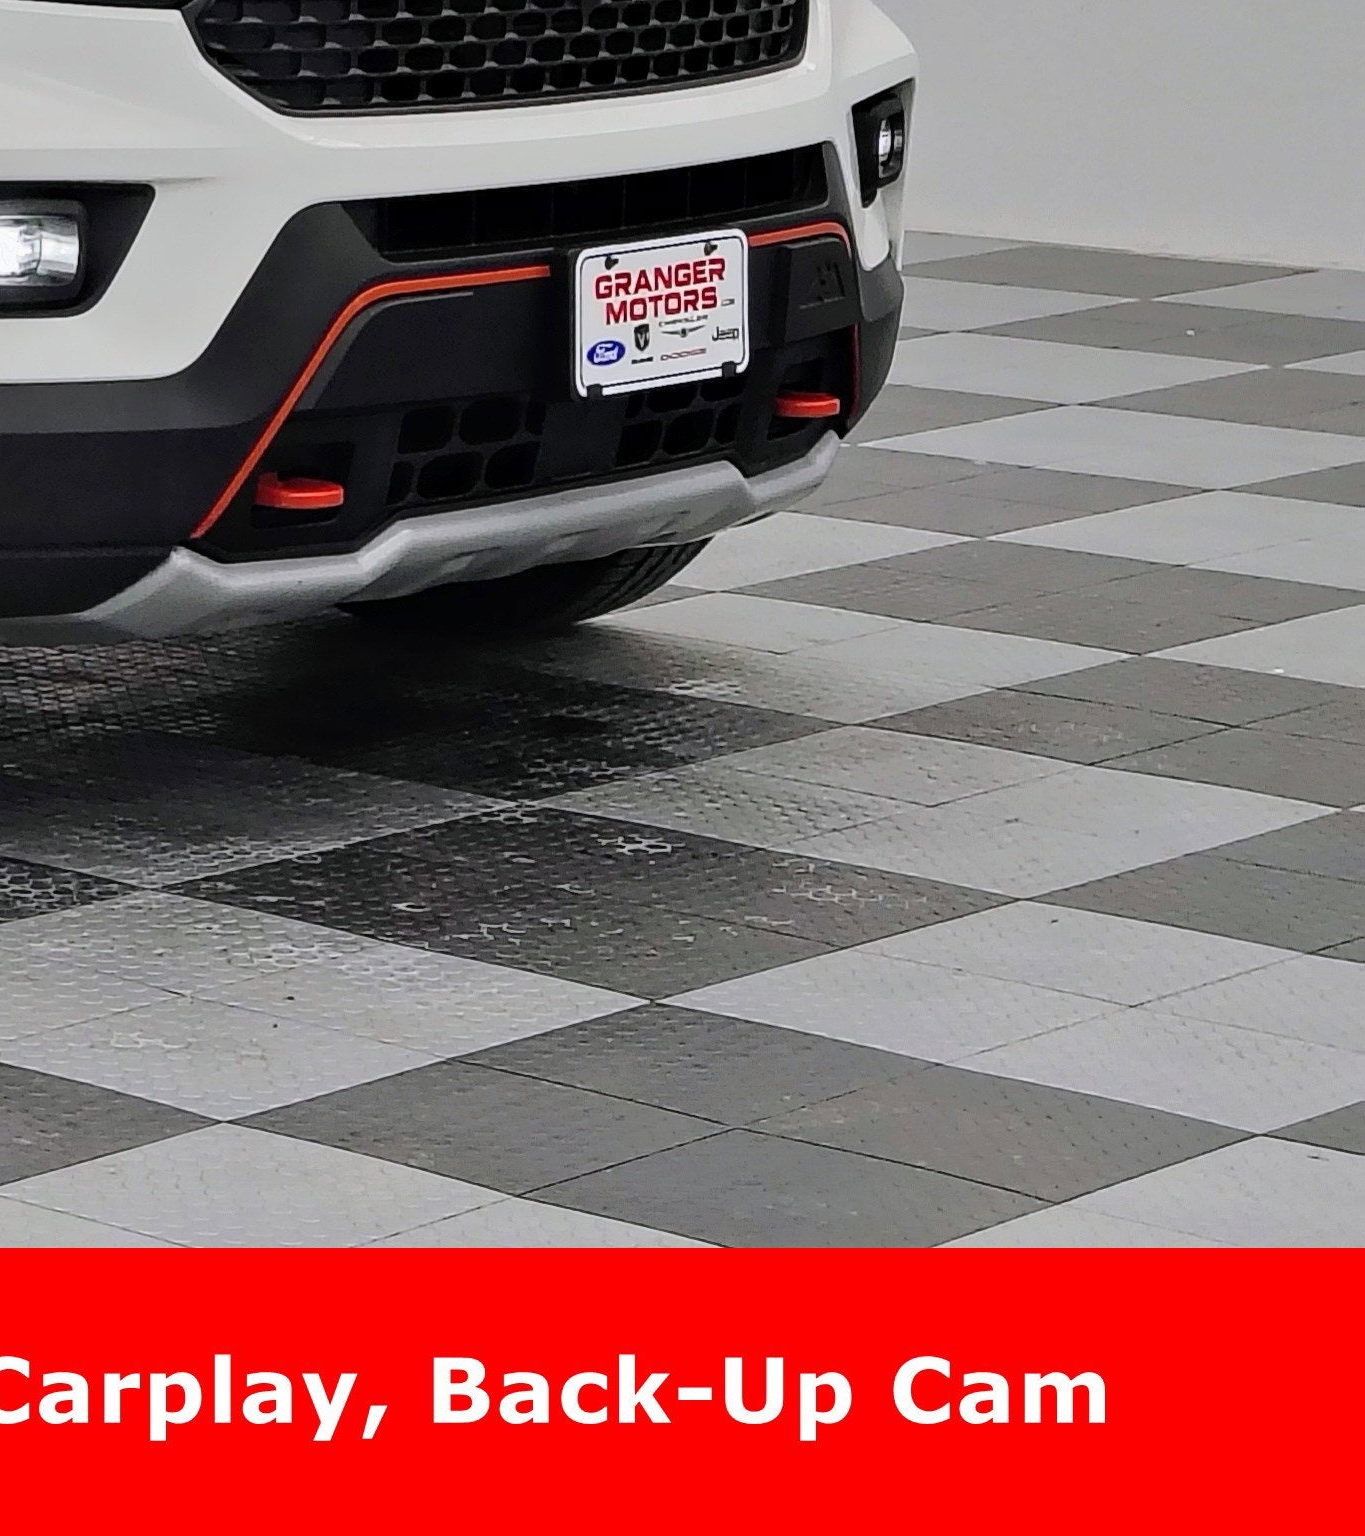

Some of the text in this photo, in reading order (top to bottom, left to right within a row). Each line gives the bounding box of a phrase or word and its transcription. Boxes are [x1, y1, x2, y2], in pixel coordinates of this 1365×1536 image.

[594, 257, 726, 300] GRANGER
[605, 286, 718, 325] MOTORS
[711, 326, 740, 341] Jeep
